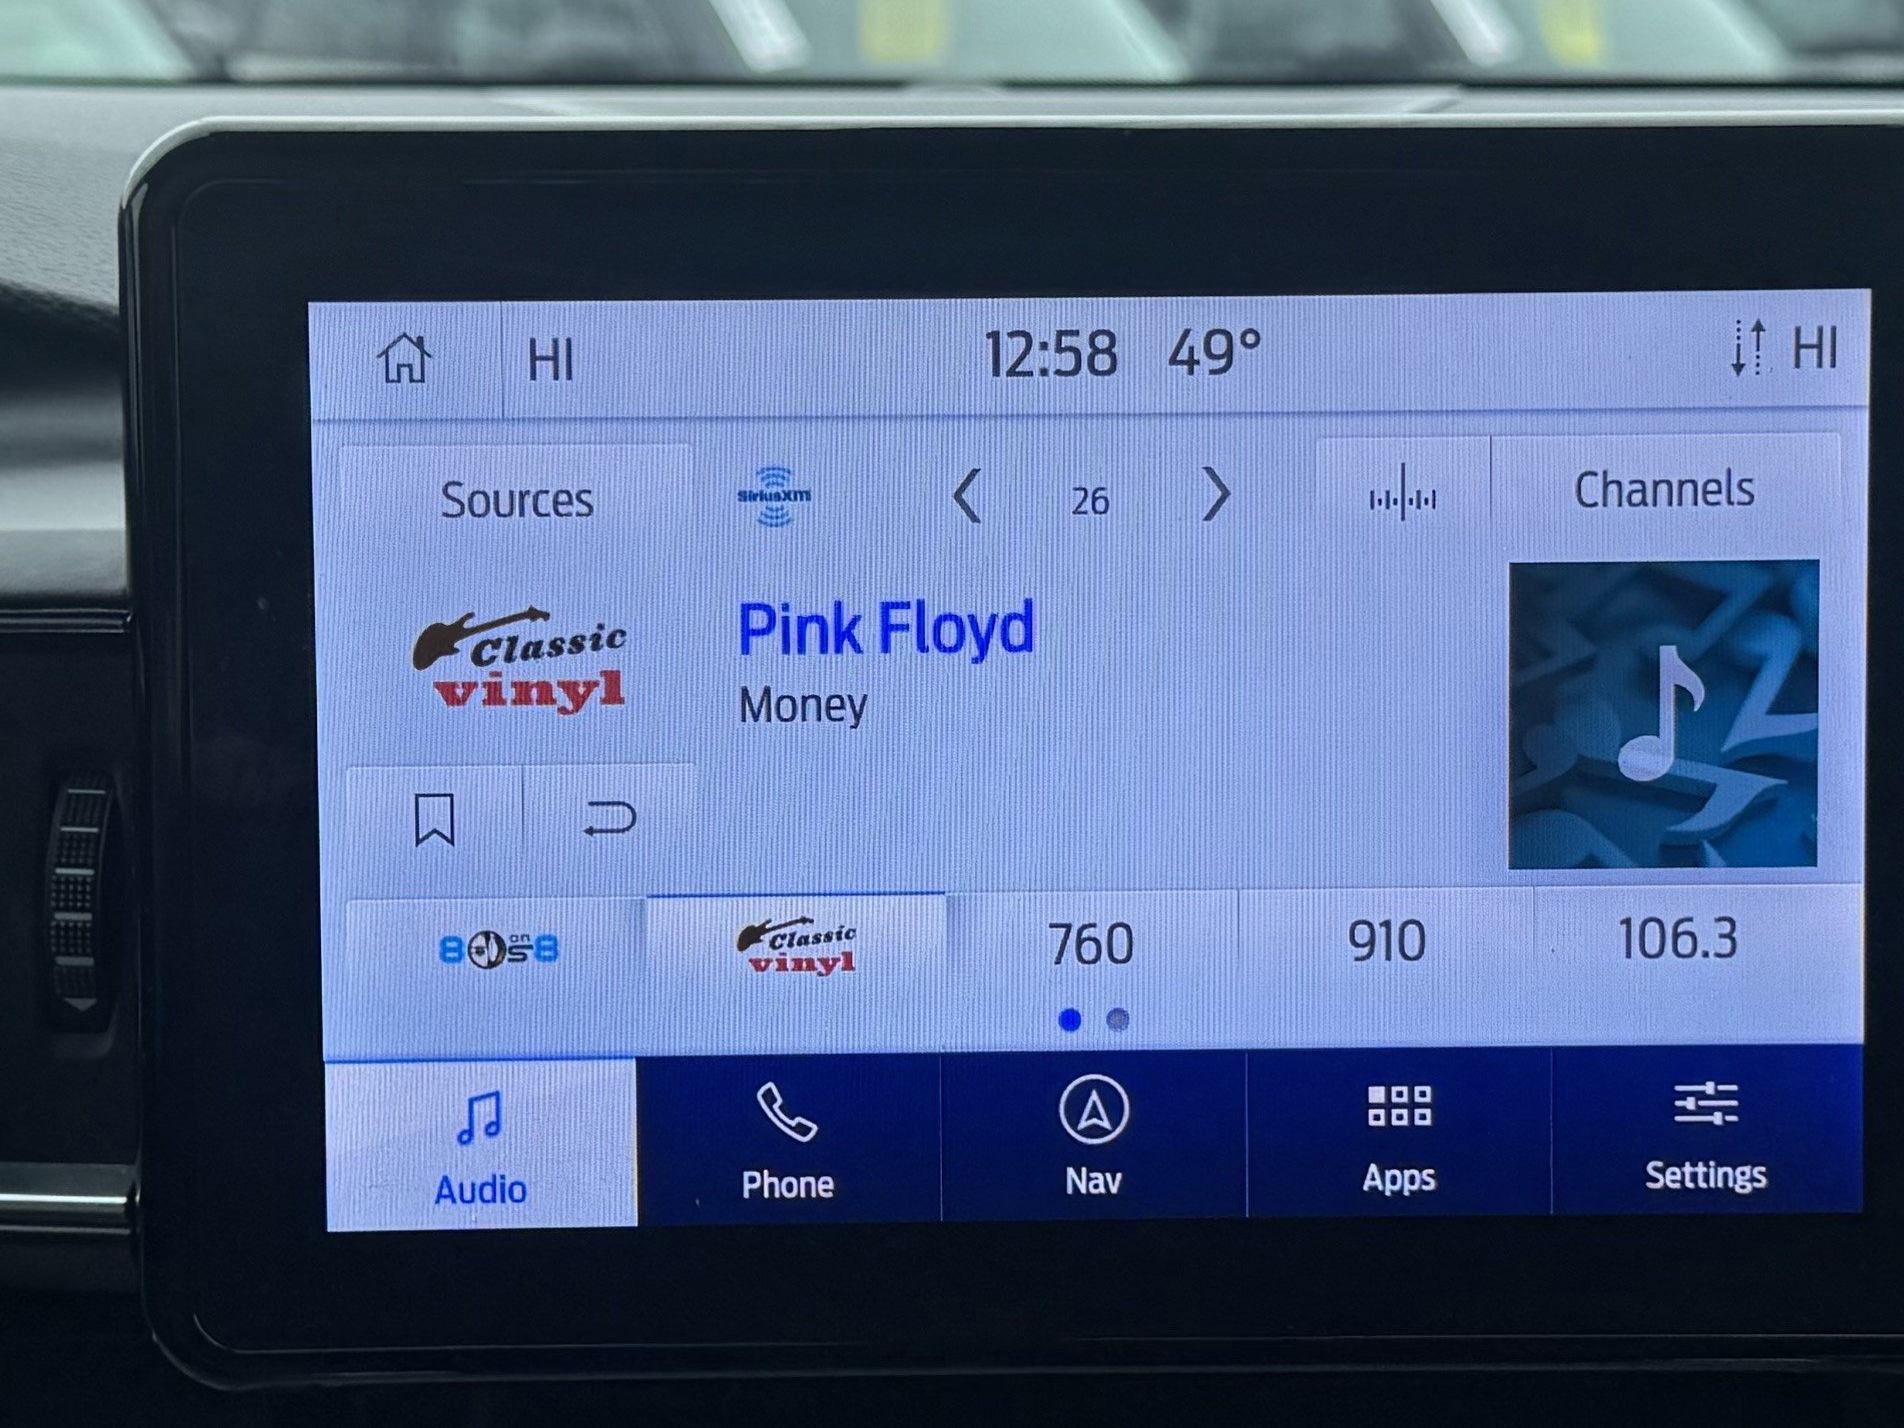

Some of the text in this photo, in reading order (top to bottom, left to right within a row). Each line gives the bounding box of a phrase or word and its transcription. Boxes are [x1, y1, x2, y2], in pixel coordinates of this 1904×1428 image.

[528, 337, 573, 381] HI
[984, 328, 1262, 378] 12:58 49°
[1793, 325, 1838, 369] HI
[441, 480, 594, 520] Sources
[1072, 486, 1110, 517] 26
[1575, 467, 1756, 508] Channels
[470, 622, 627, 668] Classic
[739, 598, 1035, 665] Pink Floyd
[433, 669, 626, 716] vinyl
[739, 686, 868, 730] Money
[769, 924, 857, 951] Classic
[1048, 920, 1135, 965] 760
[1348, 918, 1426, 962] 910
[1619, 915, 1739, 960] 106.3
[749, 950, 856, 977] vinyl
[434, 1174, 528, 1205] Audio
[742, 1171, 835, 1200] Phone
[1064, 1166, 1123, 1195] Nav
[1362, 1163, 1437, 1197] Apps
[1645, 1160, 1768, 1194] Settings
